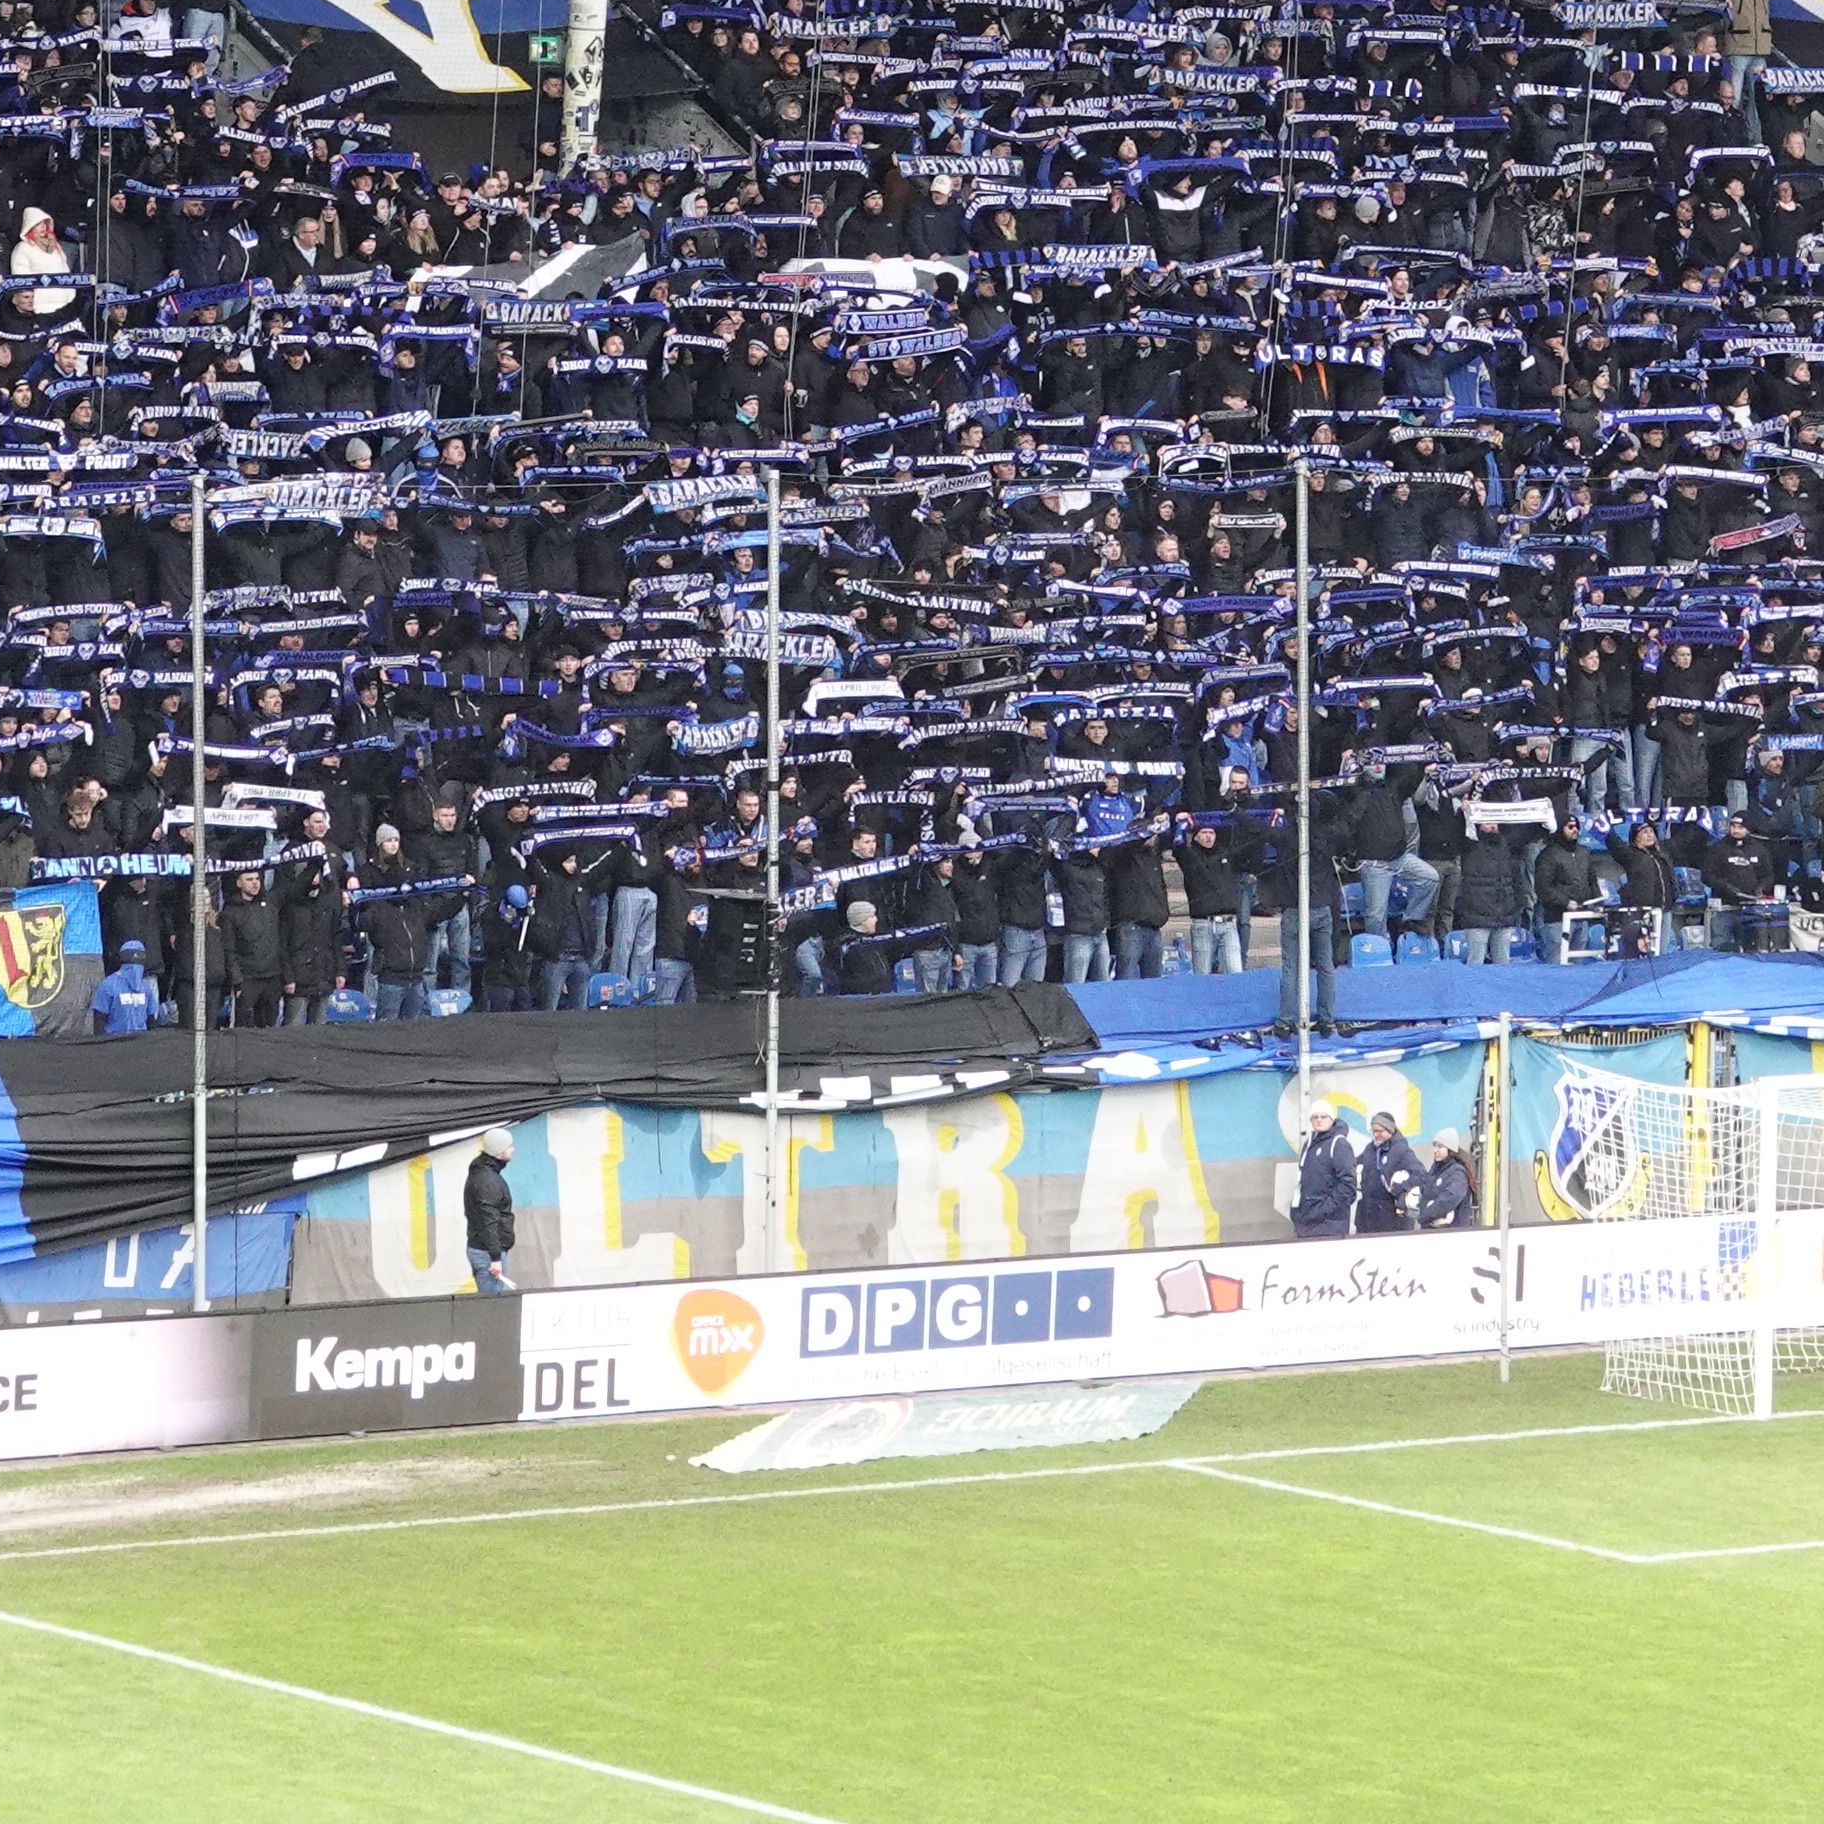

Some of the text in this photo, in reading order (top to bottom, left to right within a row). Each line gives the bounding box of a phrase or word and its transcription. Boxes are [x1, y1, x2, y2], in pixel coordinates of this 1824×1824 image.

[1096, 16, 1190, 42] BARACKLER
[1566, 2, 1656, 25] BARACKLER
[1580, 1269, 1712, 1312] HEBERLE
[808, 1282, 984, 1350] DPG
[296, 1337, 476, 1399] Kempa
[534, 1356, 631, 1412] DEL
